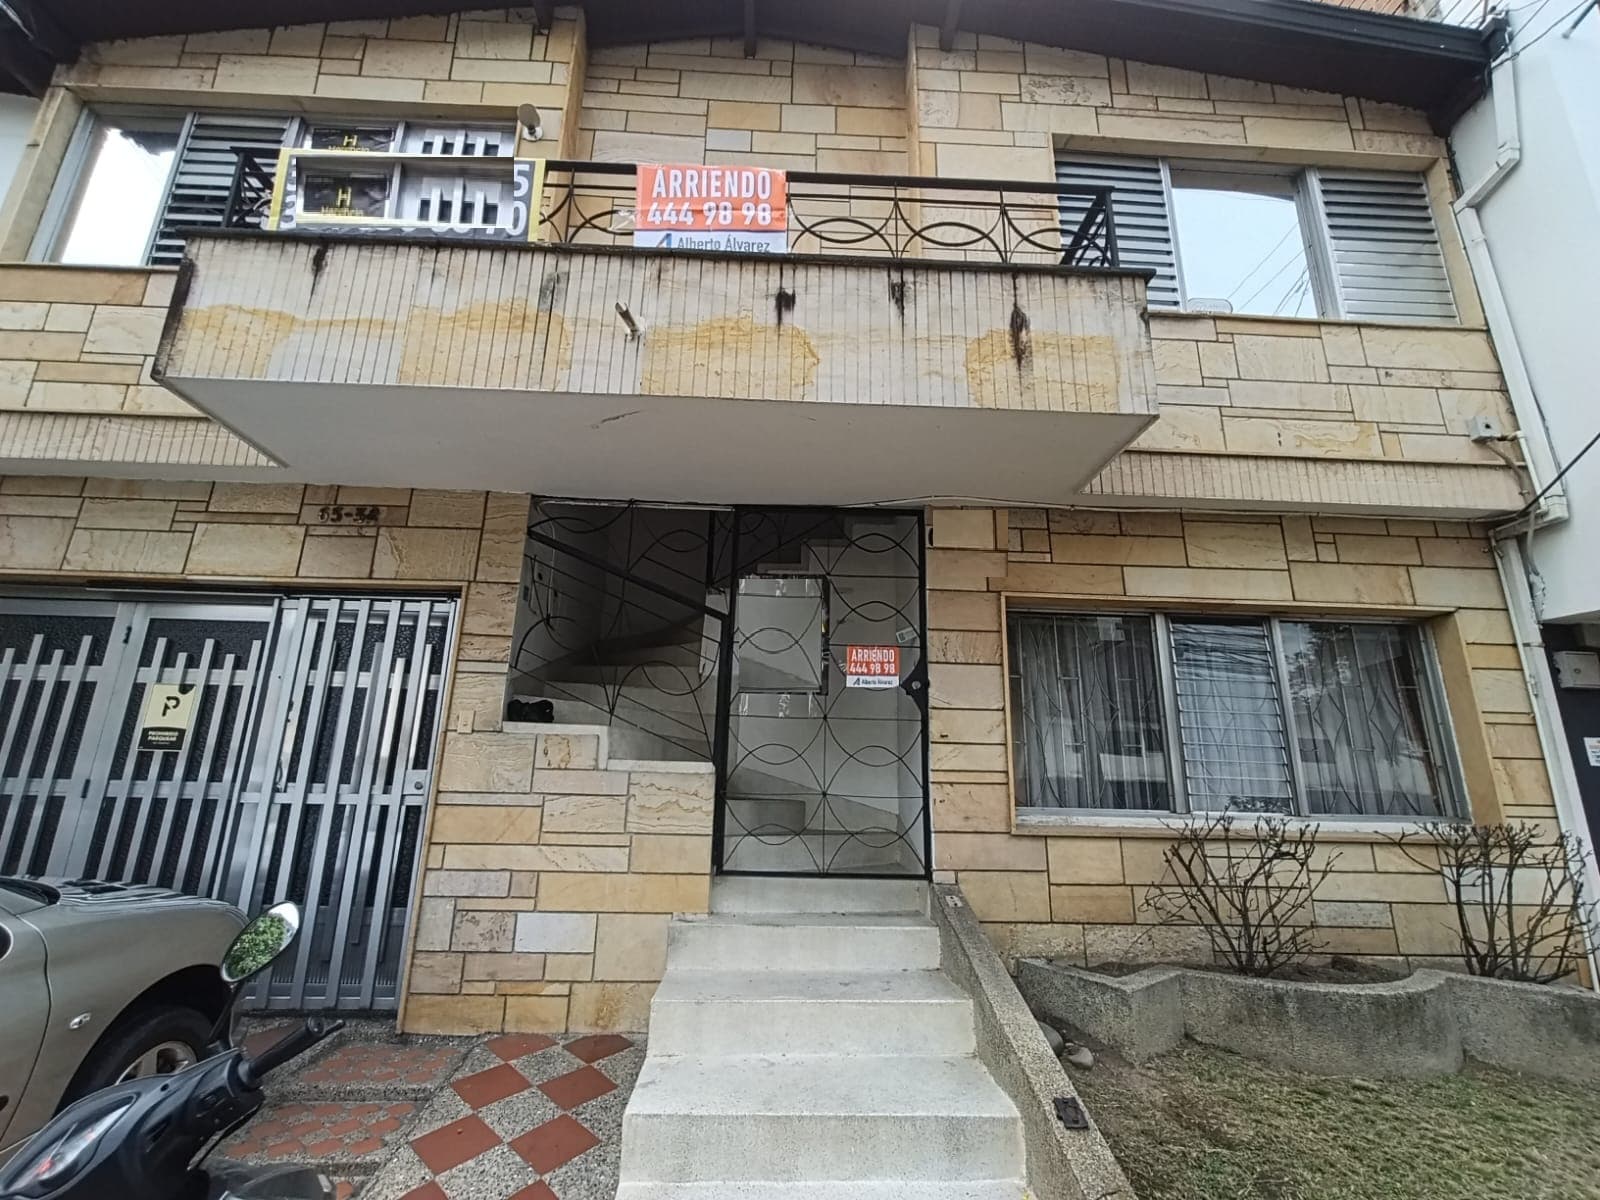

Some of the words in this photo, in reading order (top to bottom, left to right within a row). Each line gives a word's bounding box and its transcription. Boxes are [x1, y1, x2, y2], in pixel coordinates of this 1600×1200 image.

[652, 169, 771, 199] ARRIENDO
[647, 202, 694, 225] 444
[703, 201, 733, 225] 98
[741, 202, 772, 226] 98
[677, 236, 721, 251] Alberto
[723, 234, 770, 252] Álvarez
[851, 648, 895, 662] ARRIENDO
[850, 663, 868, 673] 444
[870, 663, 881, 674] 98
[884, 663, 895, 674] 98
